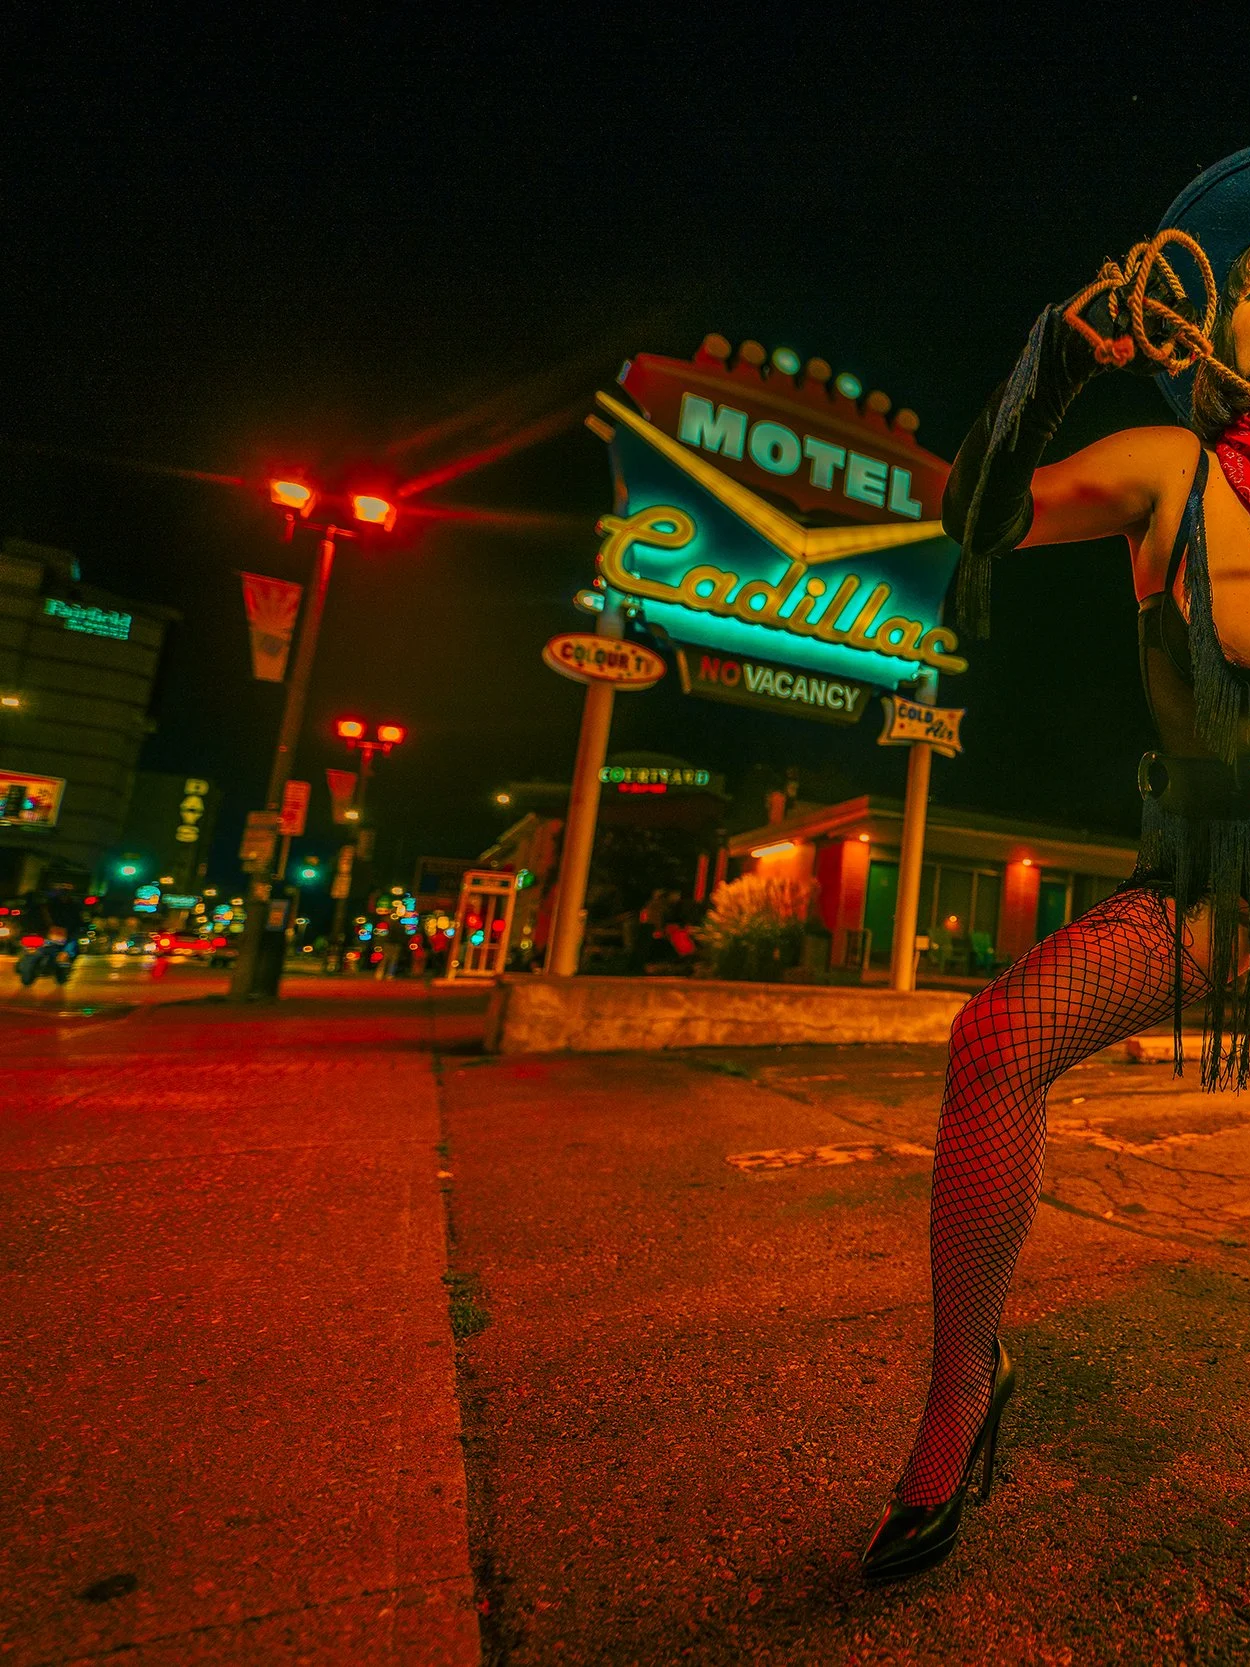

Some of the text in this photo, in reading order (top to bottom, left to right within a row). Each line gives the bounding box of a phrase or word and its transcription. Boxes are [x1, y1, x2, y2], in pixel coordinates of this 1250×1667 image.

[677, 391, 923, 520] MOTEL
[601, 505, 969, 674] Cadillac
[561, 641, 630, 669] COLOUR
[699, 655, 861, 712] NO VACANCY
[898, 704, 933, 723] COLD
[598, 766, 710, 785] COURTYARD
